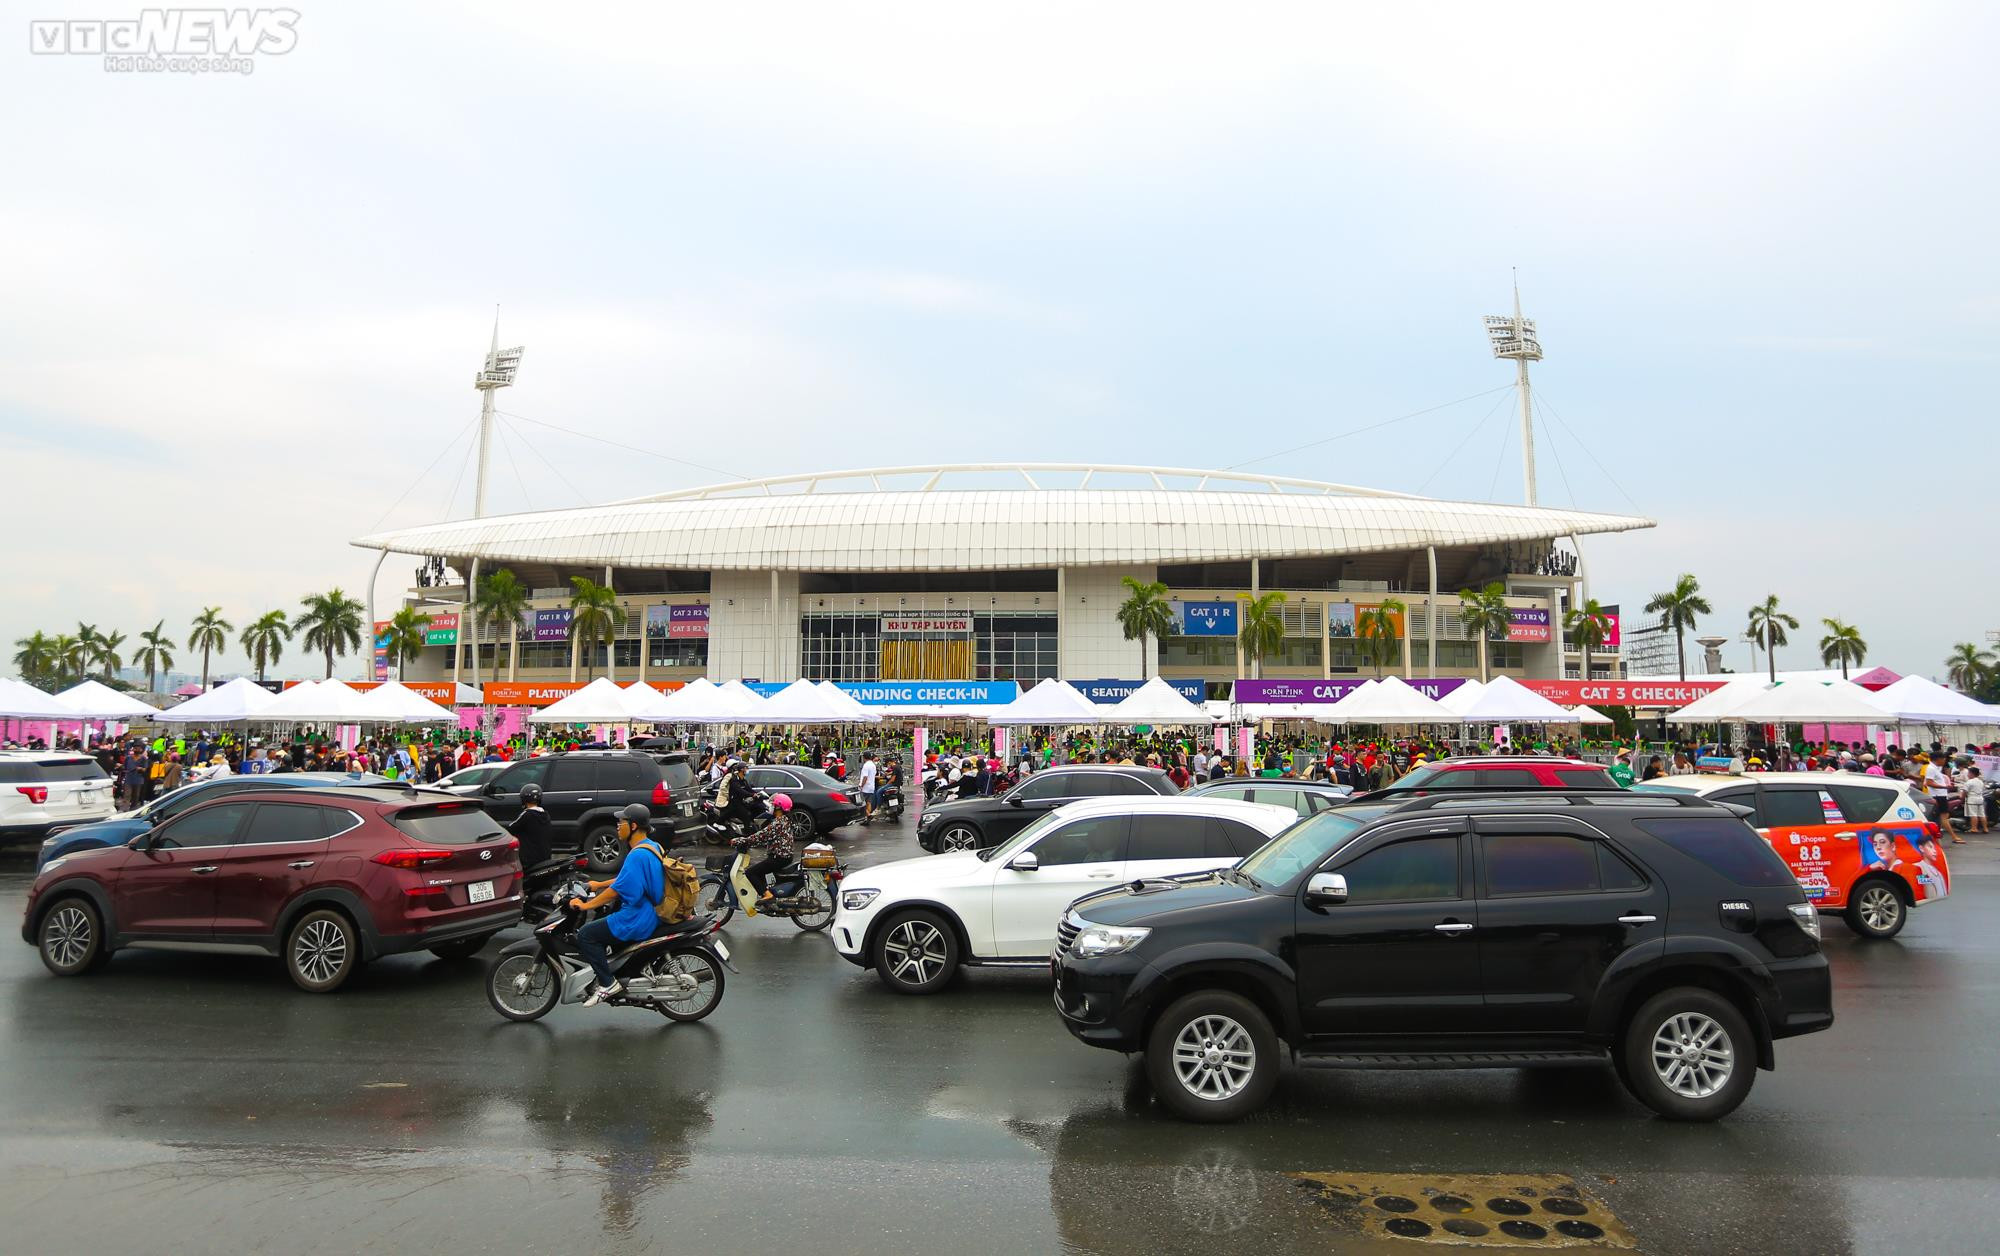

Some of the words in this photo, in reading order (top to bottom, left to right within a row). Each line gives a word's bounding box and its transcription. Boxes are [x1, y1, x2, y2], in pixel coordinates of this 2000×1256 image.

[1191, 608, 1209, 616] CAT
[1213, 608, 1218, 616] 1
[1223, 608, 1230, 616] R
[888, 621, 908, 630] KHU
[911, 621, 930, 631] TẬP
[933, 620, 967, 631] LUYỆN
[411, 689, 449, 698] ECK-IN
[528, 689, 577, 698] PLATINU
[843, 688, 912, 700] TANDING
[917, 688, 987, 700] CHECK-IN
[1313, 686, 1342, 698] CAT
[1580, 687, 1610, 699] CAT
[1616, 687, 1626, 699] 3
[1632, 687, 1710, 700] CHECK-IN
[1615, 771, 1631, 780] Grab
[1800, 835, 1826, 844] Shopee
[1799, 845, 1821, 861] 8.8
[1808, 878, 1828, 886] 50%
[1722, 902, 1750, 911] DIESEL
